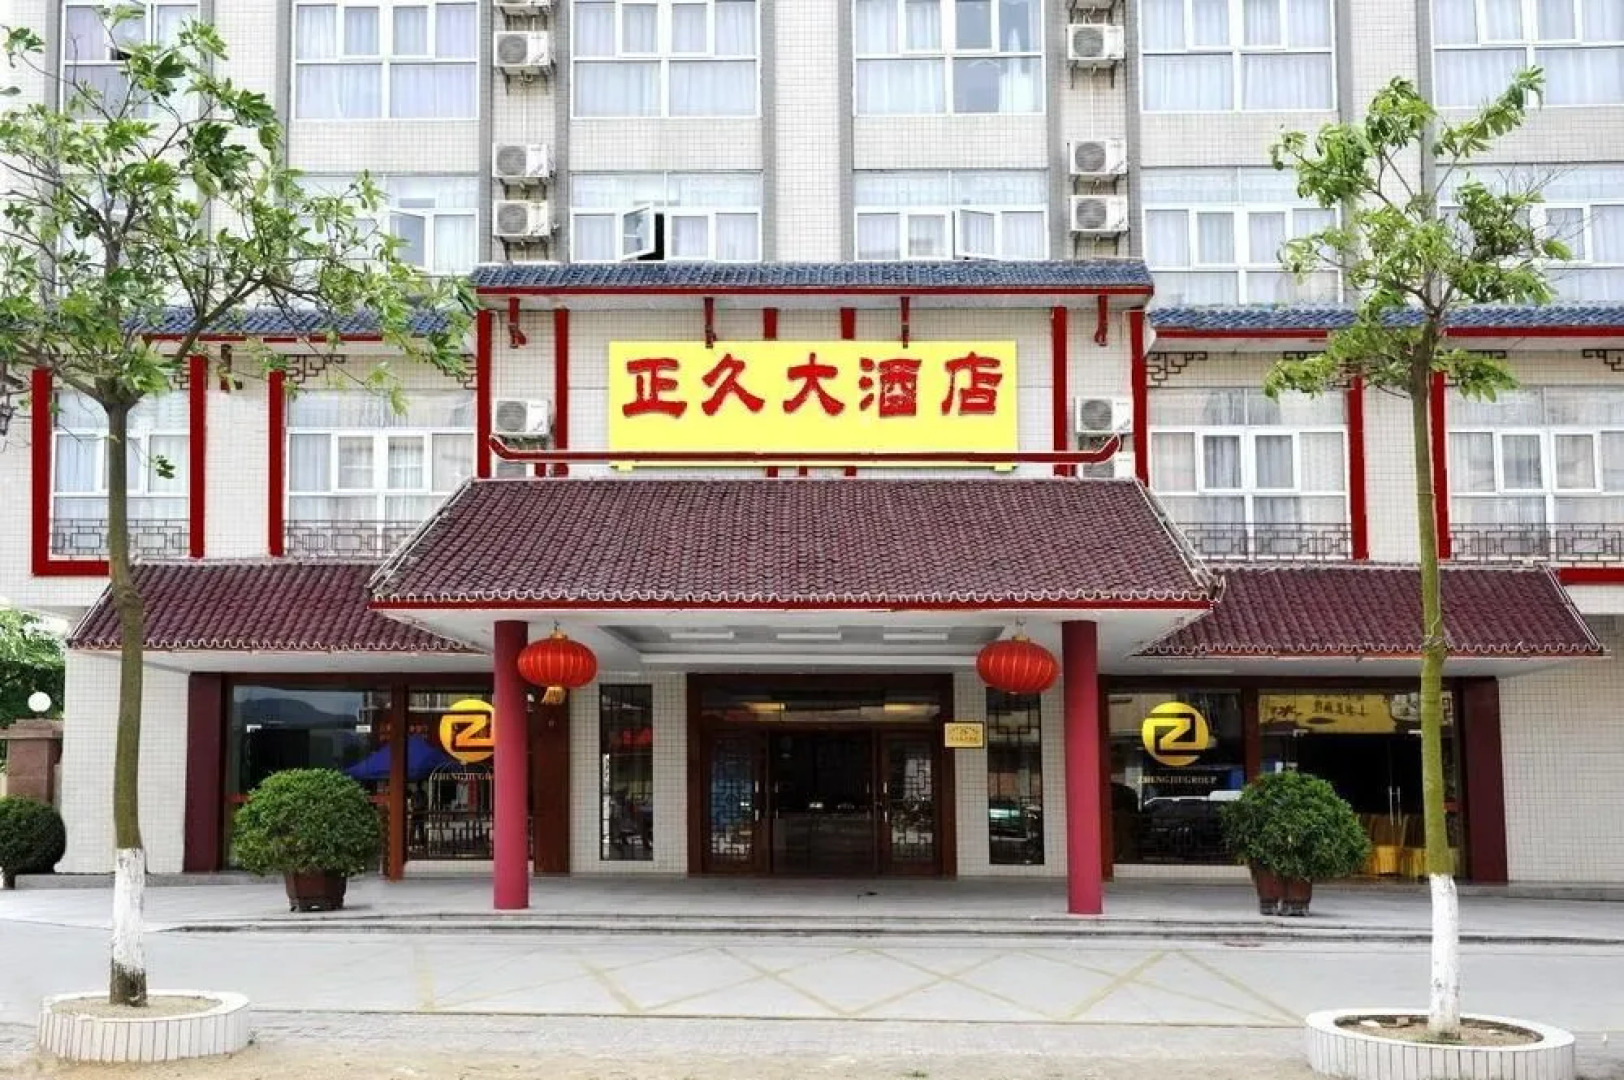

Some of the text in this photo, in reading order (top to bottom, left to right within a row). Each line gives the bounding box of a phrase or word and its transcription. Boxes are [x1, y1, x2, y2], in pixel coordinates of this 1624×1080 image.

[622, 352, 1002, 418] 正久大酒店
